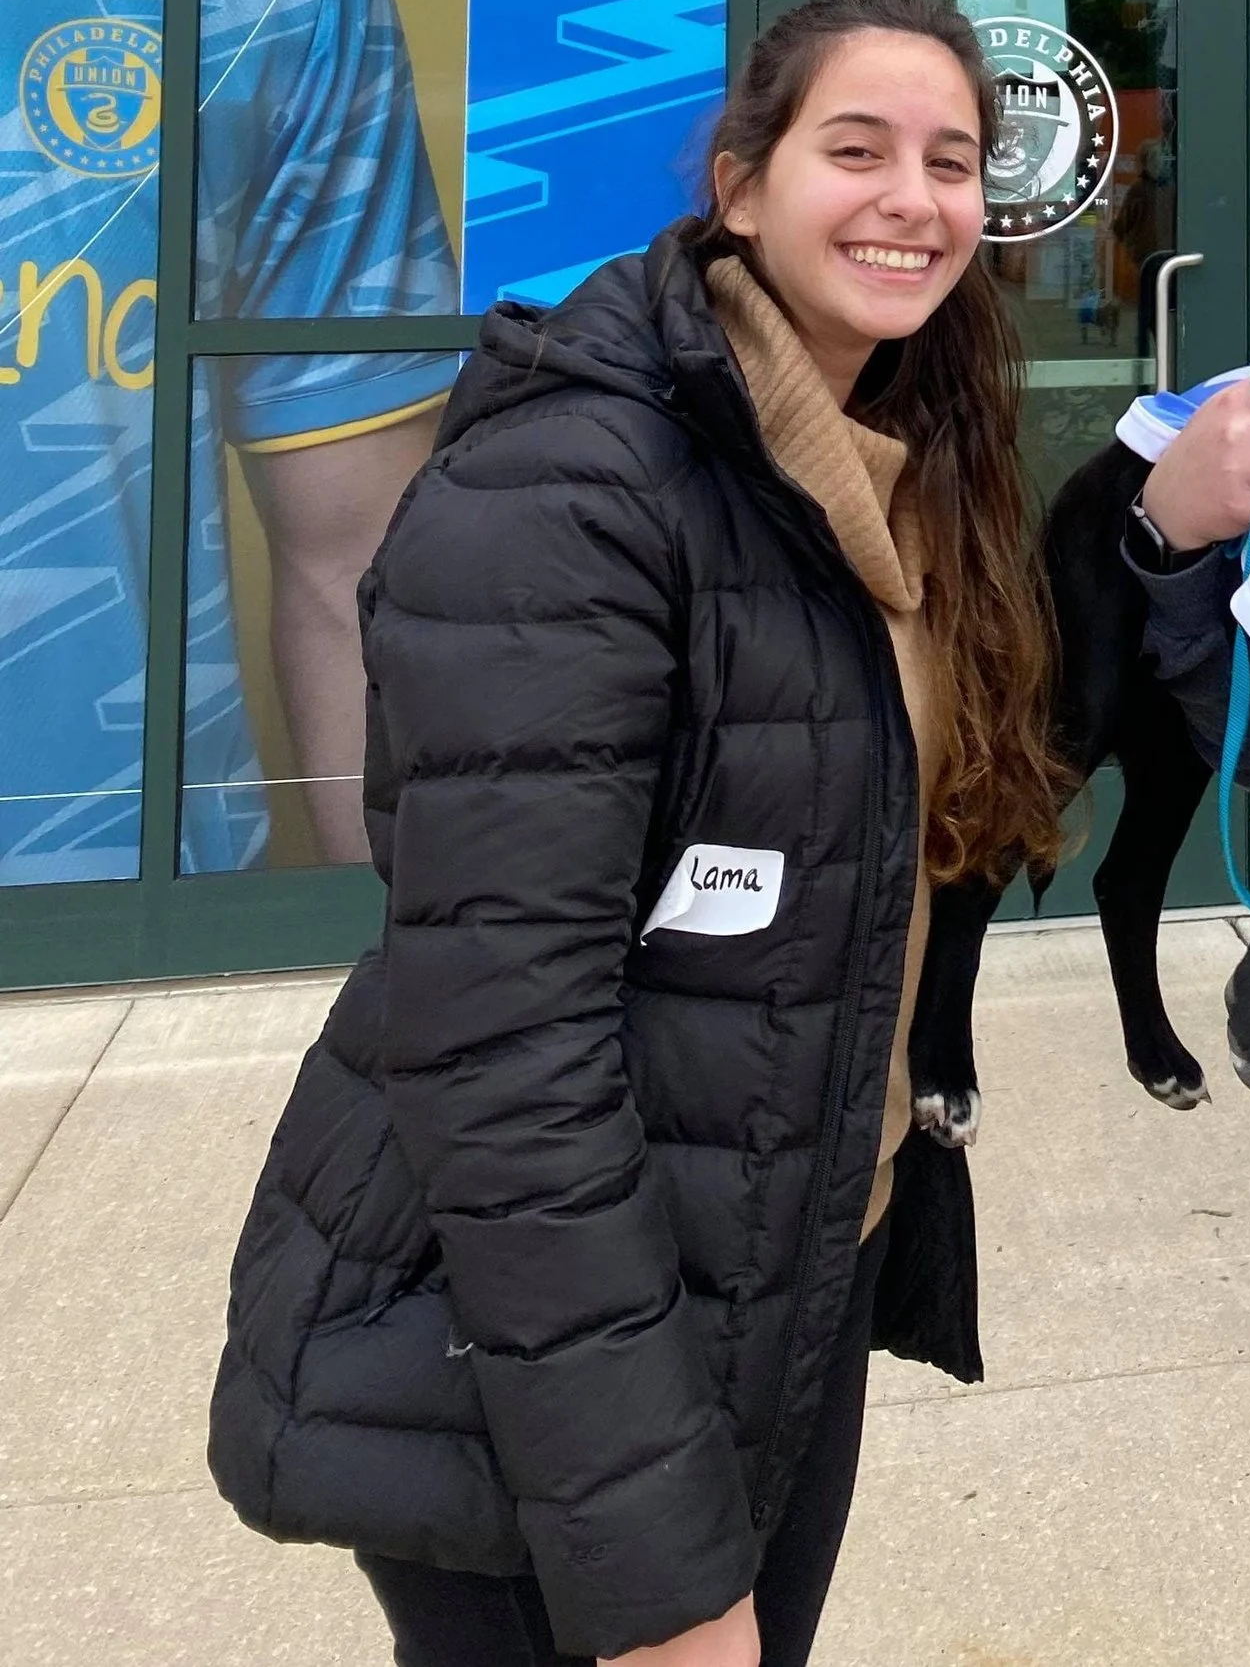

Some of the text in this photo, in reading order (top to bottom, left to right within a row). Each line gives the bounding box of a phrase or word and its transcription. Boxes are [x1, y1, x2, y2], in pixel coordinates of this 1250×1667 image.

[74, 66, 136, 87] UNION
[979, 28, 1106, 121] DELPHIA
[690, 856, 764, 893] Lama
